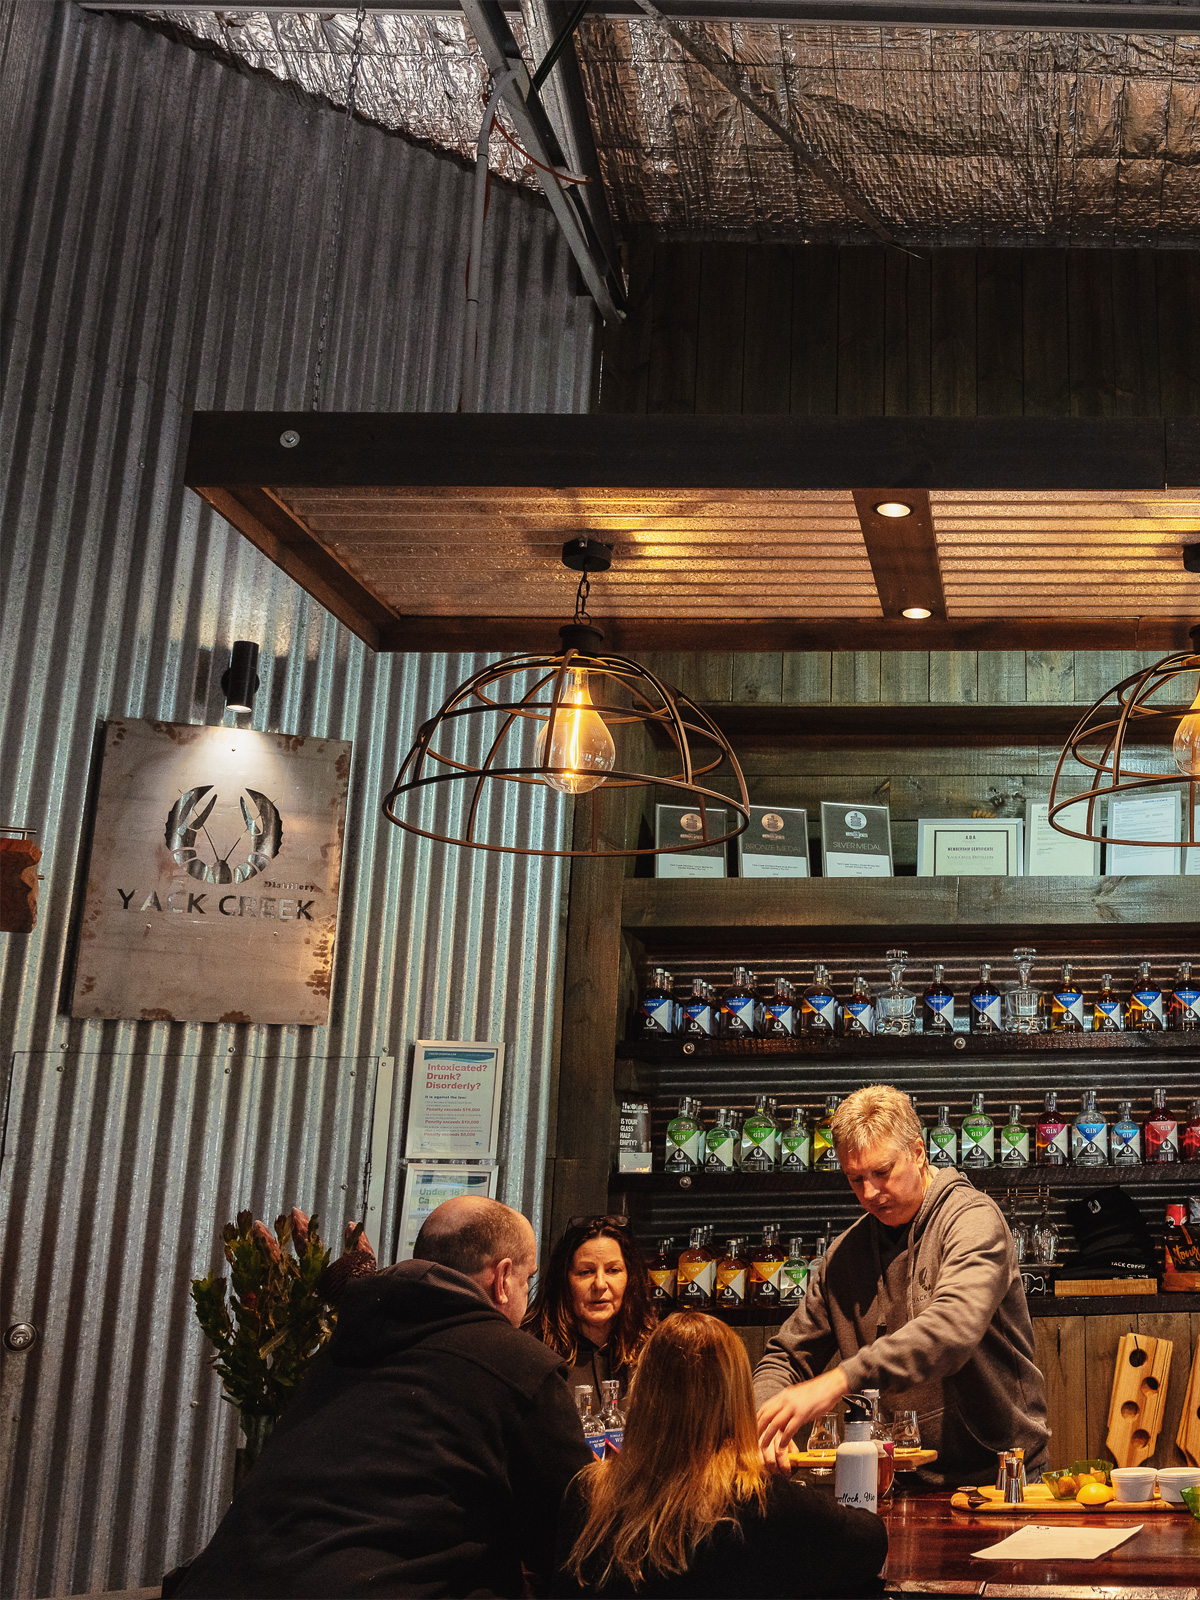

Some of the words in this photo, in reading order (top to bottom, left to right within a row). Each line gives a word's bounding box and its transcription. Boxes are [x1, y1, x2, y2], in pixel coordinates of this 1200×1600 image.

[745, 842, 775, 850] BRONZE
[832, 841, 855, 849] SILVER
[264, 880, 315, 891] Distillery
[117, 888, 207, 914] YACK
[218, 894, 315, 921] CREEK
[427, 1063, 488, 1072] Intoxicated?
[426, 1072, 461, 1080] Drunk?
[426, 1081, 481, 1091] Disorderly?
[419, 1188, 447, 1196] Under
[450, 1188, 465, 1196] 18?
